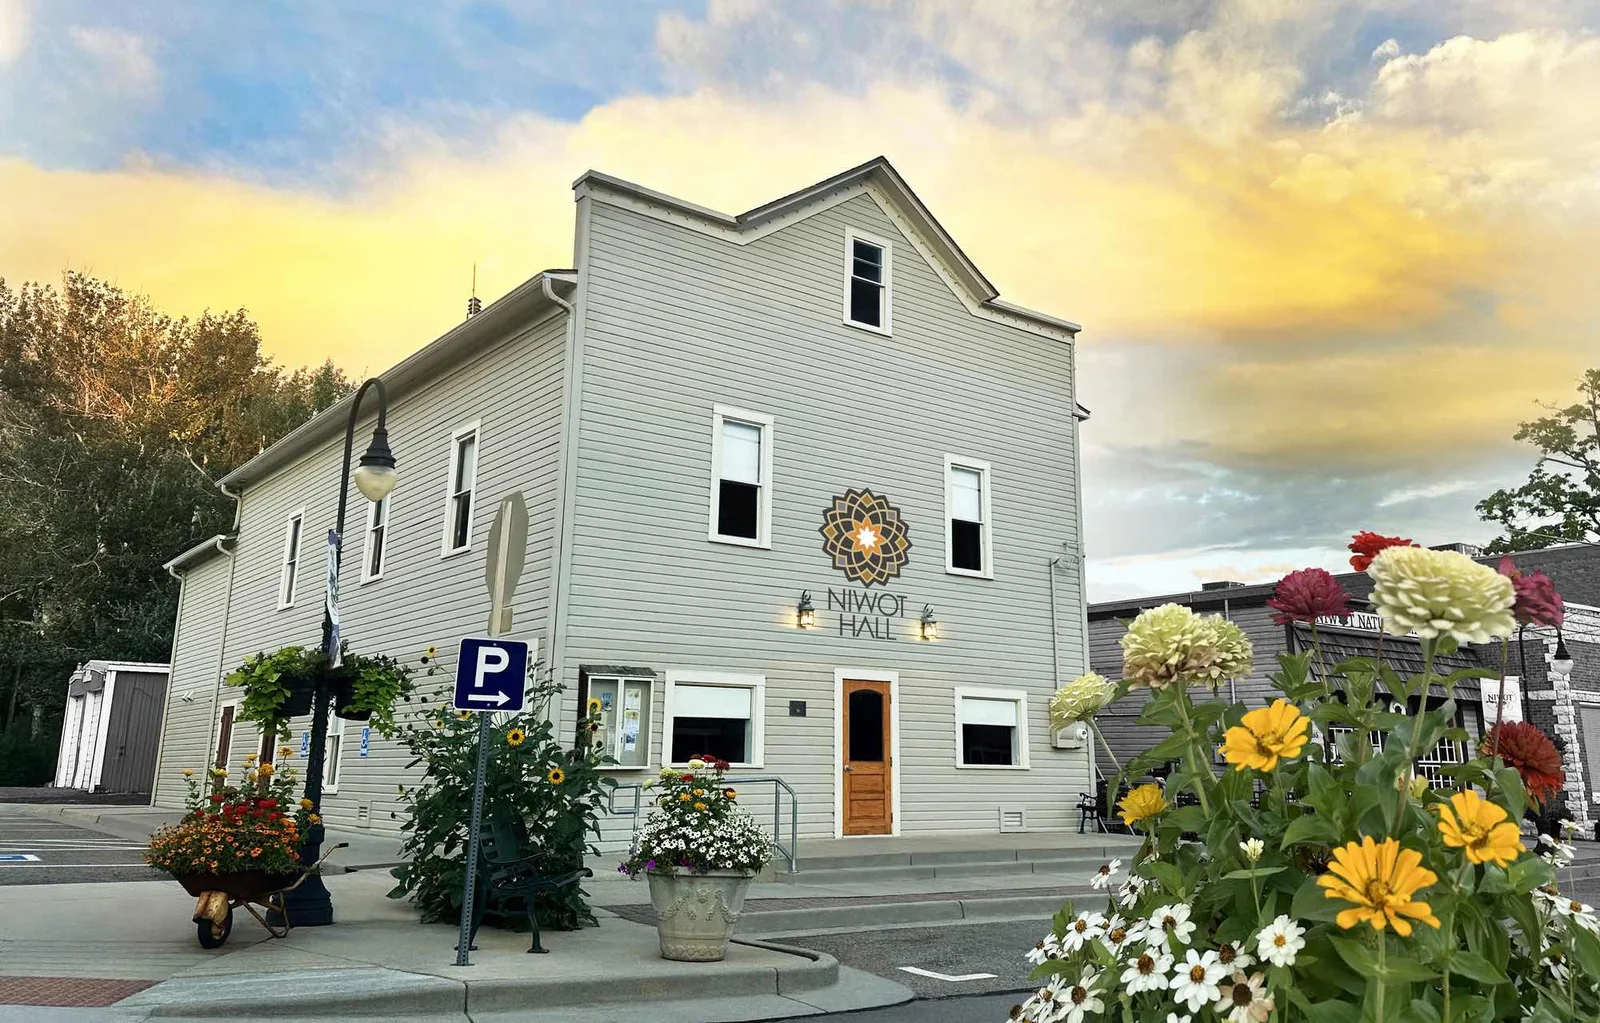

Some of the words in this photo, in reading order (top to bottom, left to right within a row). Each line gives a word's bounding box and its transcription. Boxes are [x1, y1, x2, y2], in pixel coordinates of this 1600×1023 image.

[828, 587, 907, 618] NIWOT
[840, 613, 896, 640] HALL
[474, 646, 510, 687] P
